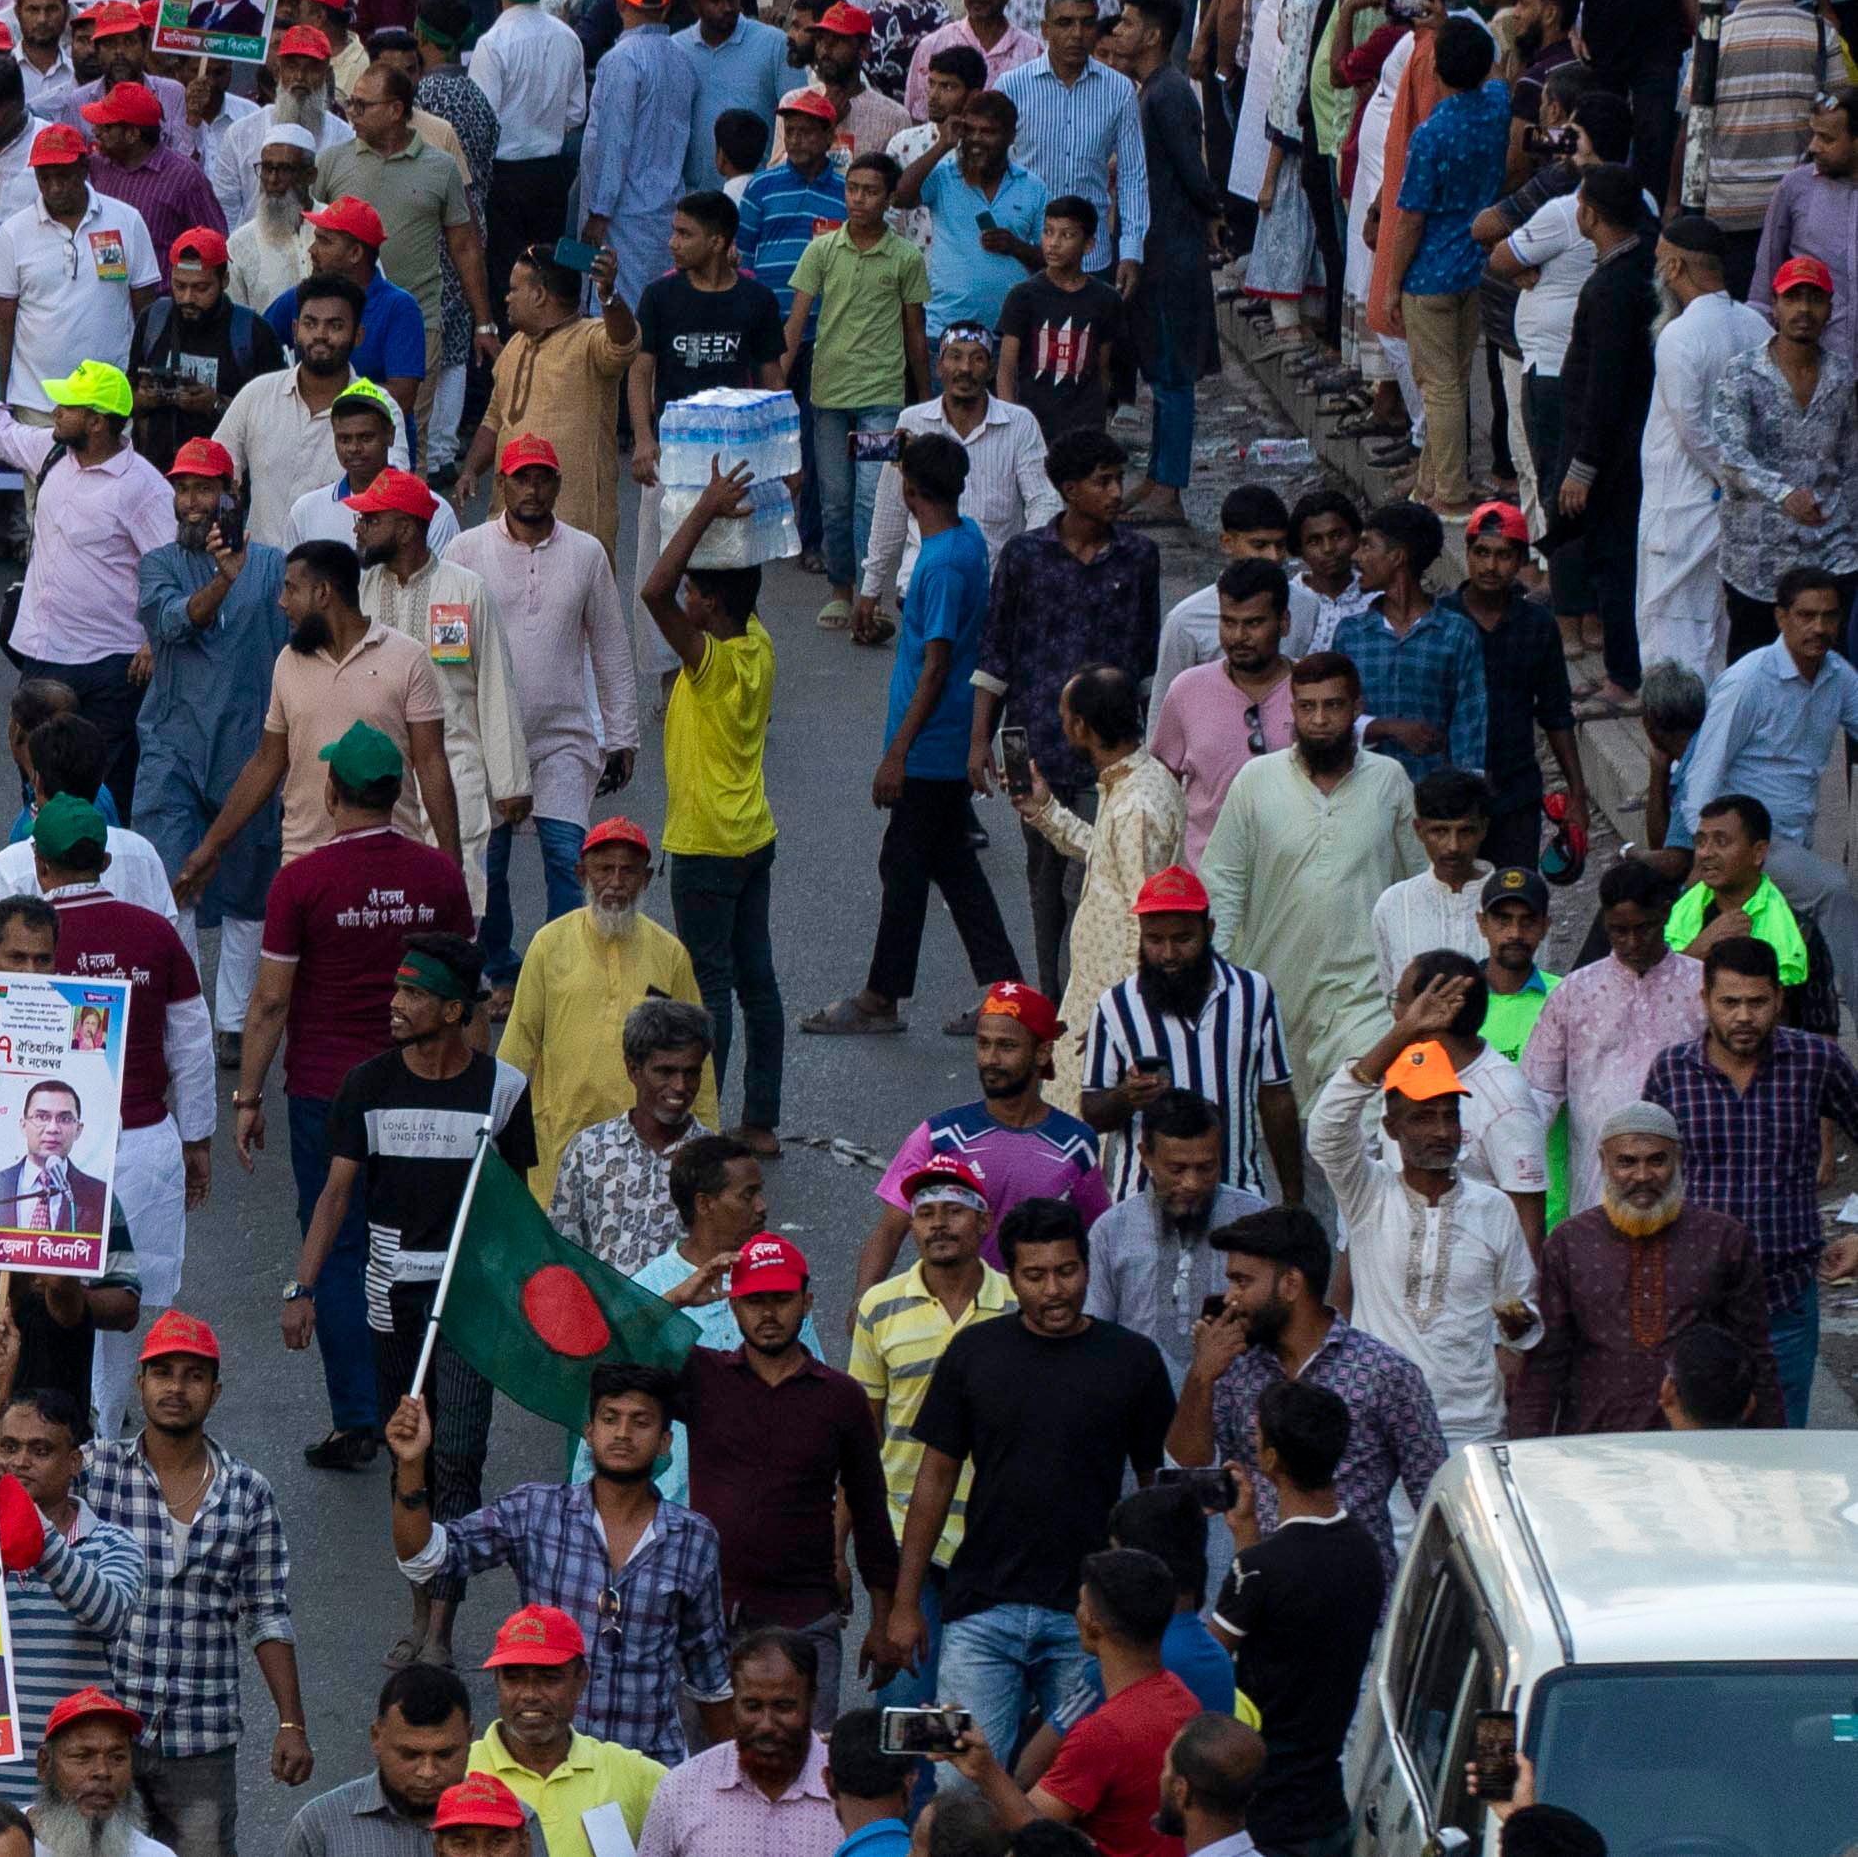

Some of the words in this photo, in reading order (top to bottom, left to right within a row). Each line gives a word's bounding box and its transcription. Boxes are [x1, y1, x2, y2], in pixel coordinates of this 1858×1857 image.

[15, 1040, 64, 1056] ঐতিহাসিক
[28, 1056, 62, 1071] নভেম্বর
[382, 1121, 409, 1132] LONG
[413, 1122, 435, 1132] LIVE
[391, 1130, 457, 1143] UNDERSTAND
[37, 1238, 92, 1262] বিএনপি
